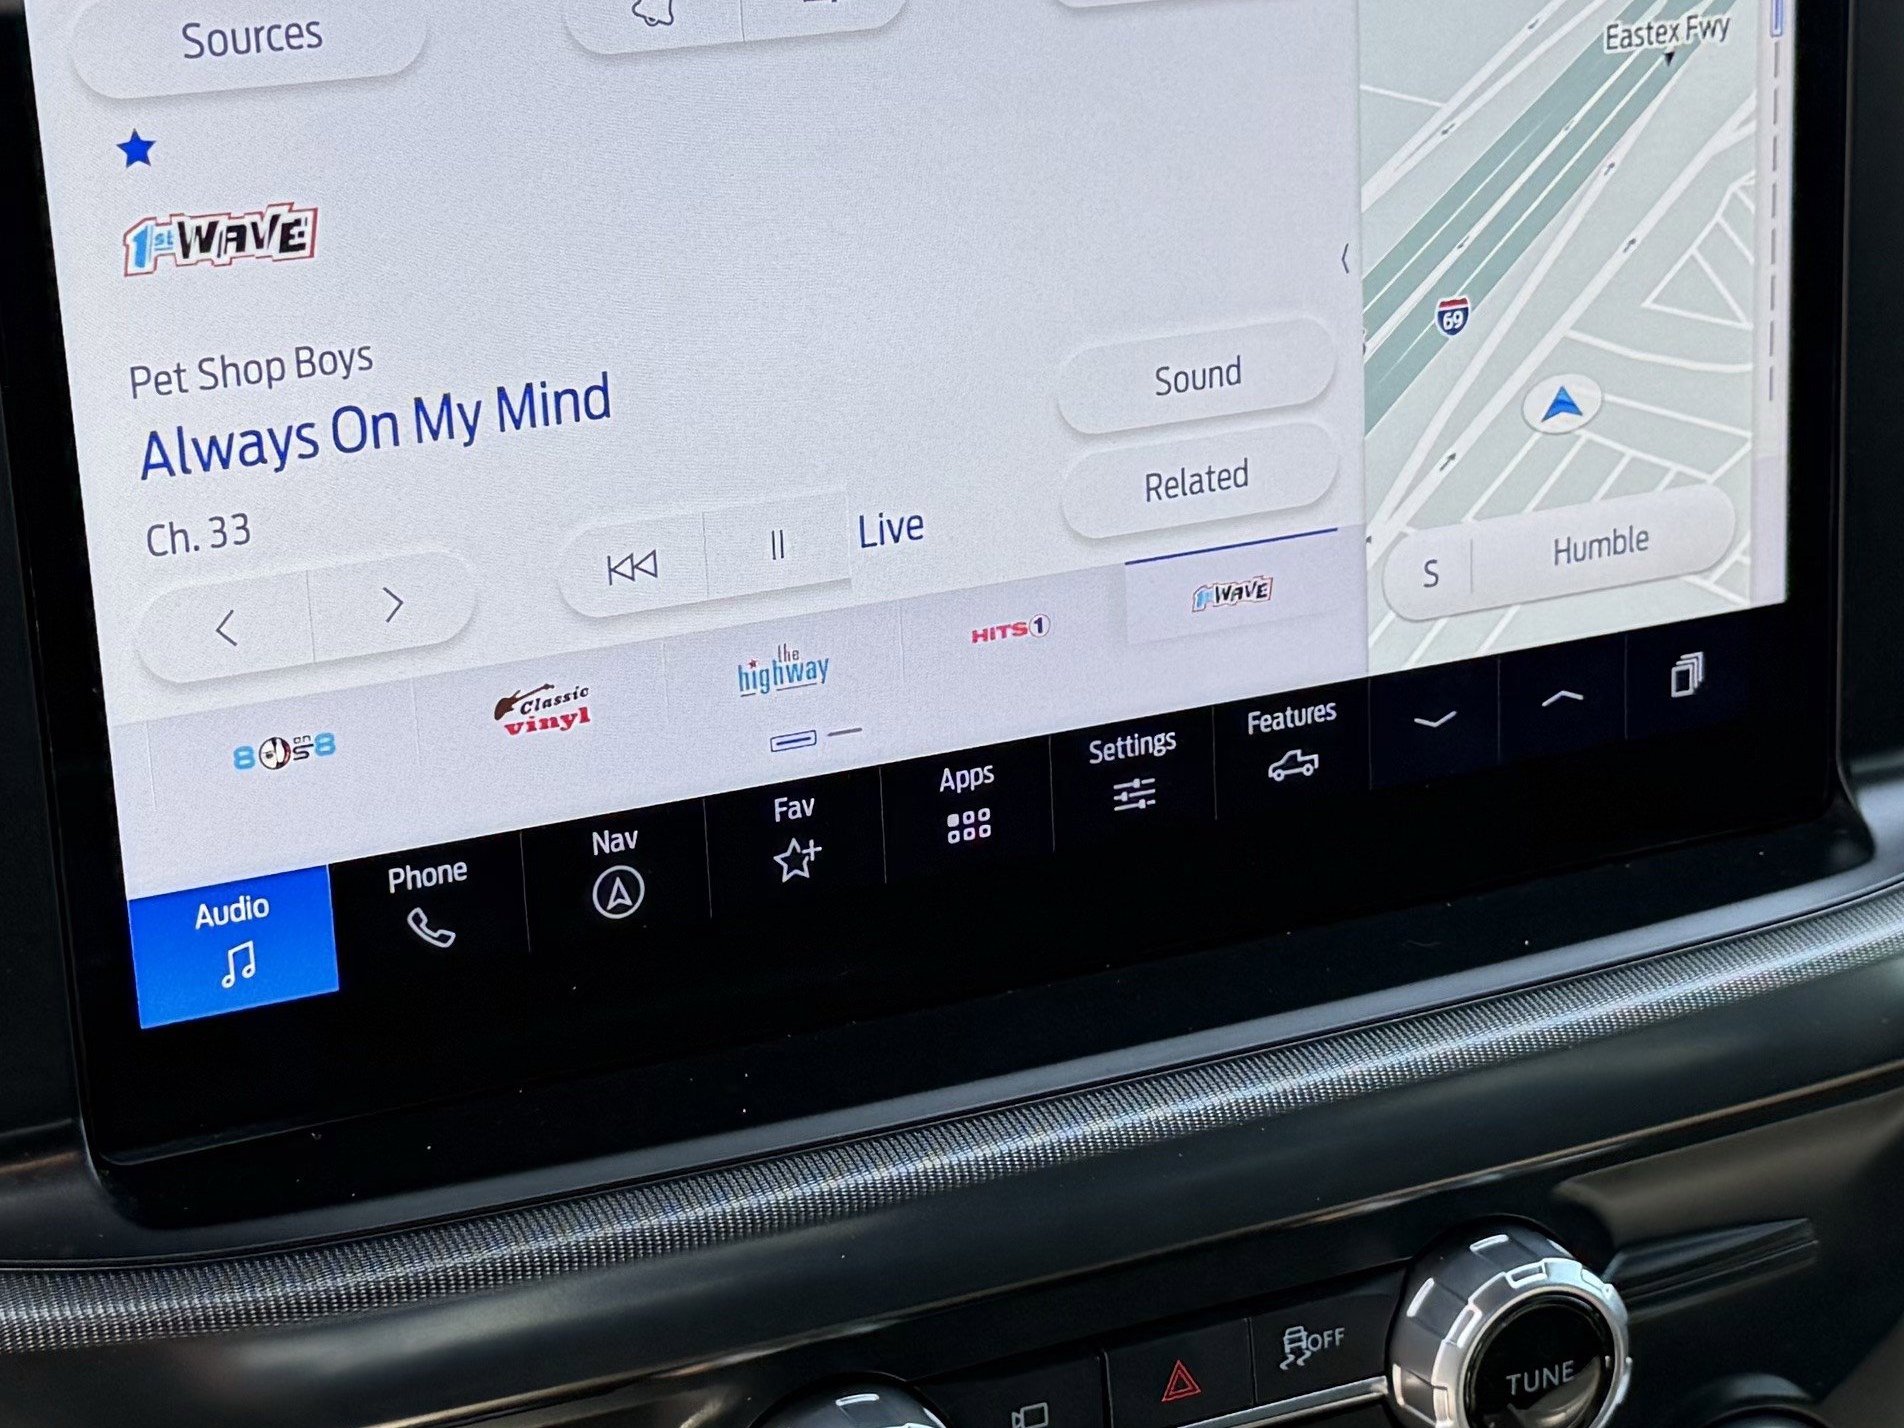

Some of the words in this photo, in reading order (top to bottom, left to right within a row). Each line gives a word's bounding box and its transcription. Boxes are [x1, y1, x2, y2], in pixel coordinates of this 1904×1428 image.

[181, 20, 323, 59] Sources
[1605, 21, 1680, 51] Eastex
[1685, 14, 1731, 43] Fwy
[176, 213, 308, 260] WAVE
[1442, 310, 1464, 331] 69
[130, 362, 189, 400] Pet
[197, 354, 286, 391] Shop
[294, 345, 373, 380] Boys
[1155, 354, 1242, 396] Sound
[140, 422, 320, 481] Always
[331, 405, 400, 454] On
[413, 392, 482, 448] My
[496, 370, 611, 433] Mind
[1145, 457, 1249, 503] Related
[146, 521, 200, 557] Ch.
[208, 512, 251, 549] 33
[859, 512, 924, 549] Live
[1423, 558, 1439, 588] S
[1554, 524, 1650, 566] Humble
[1215, 580, 1269, 604] WAVE
[971, 621, 1028, 644] HITS
[776, 642, 800, 663] the
[736, 657, 830, 694] highway
[519, 684, 590, 716] Classic
[1246, 698, 1338, 736] Features
[503, 705, 591, 736] vinyl
[1087, 727, 1178, 765] Settings
[939, 764, 995, 794] Apps
[774, 796, 815, 823] Fav
[592, 829, 639, 856] Nav
[388, 861, 468, 894] Phone
[195, 895, 270, 930] Audio
[1307, 1327, 1345, 1352] OFF
[1505, 1359, 1575, 1396] TUNE
